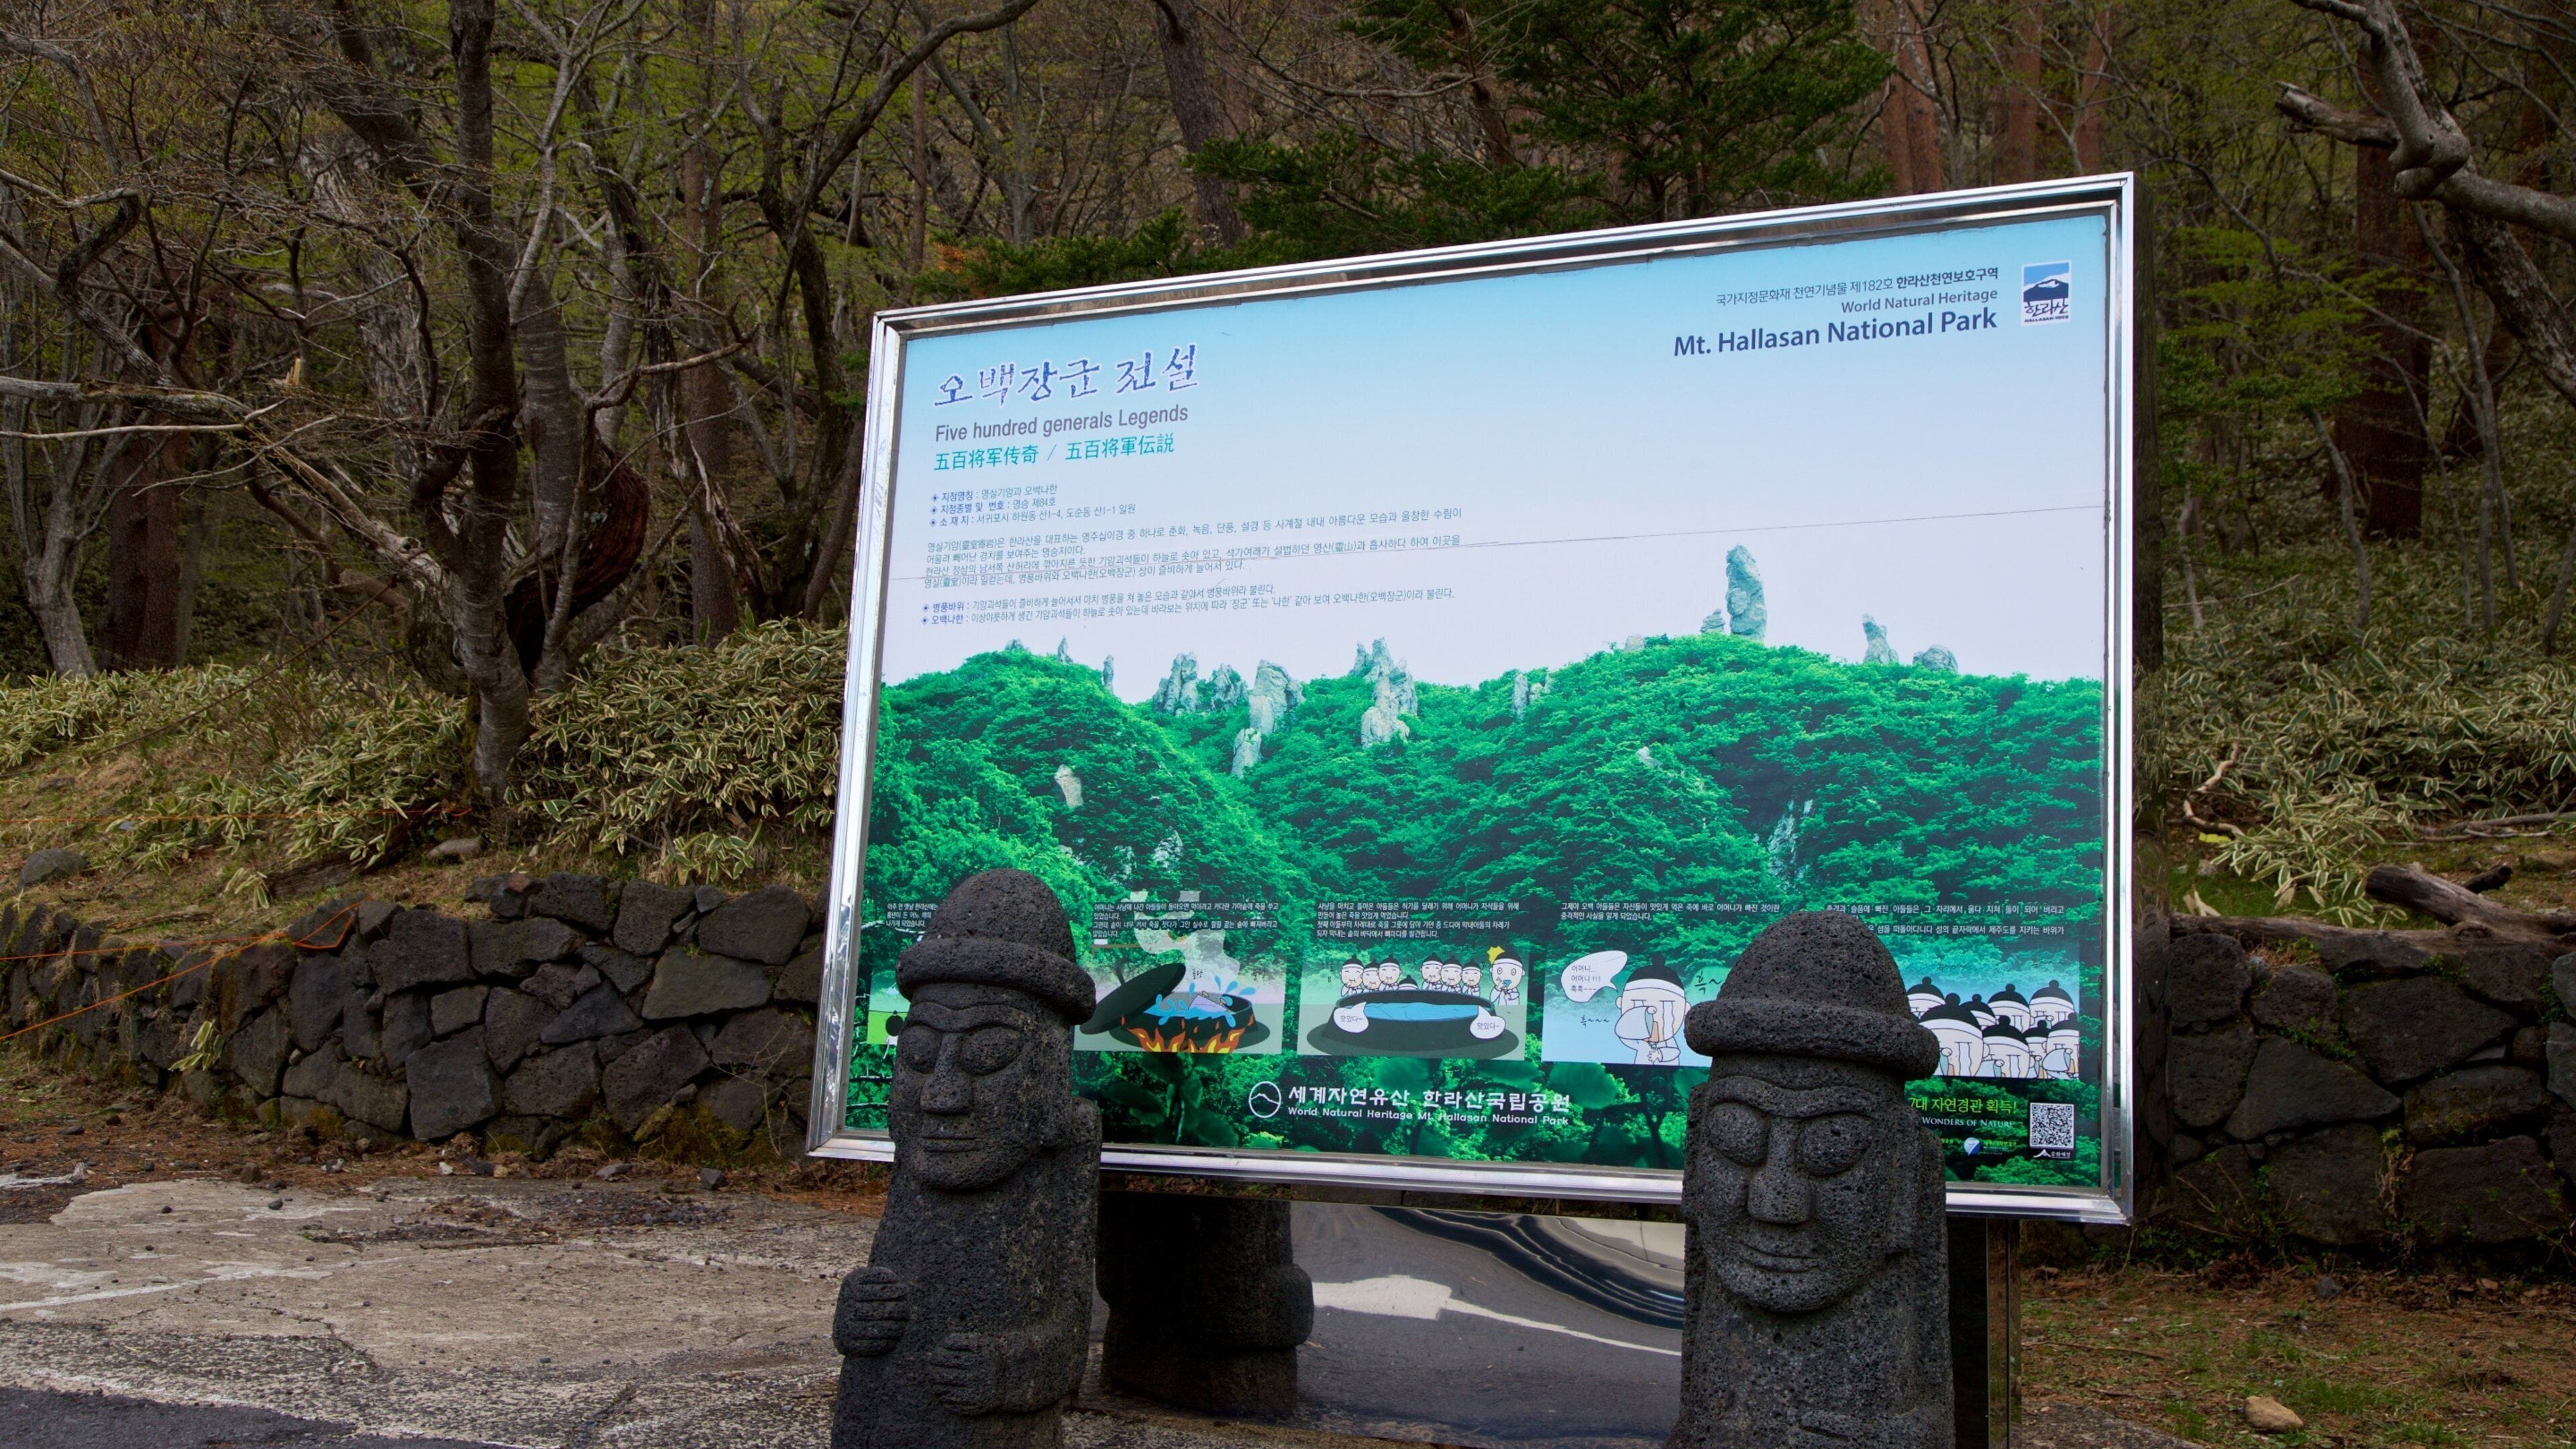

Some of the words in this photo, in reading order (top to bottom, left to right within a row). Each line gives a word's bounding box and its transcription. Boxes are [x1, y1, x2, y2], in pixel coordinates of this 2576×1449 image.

[1716, 287, 1790, 305] 국가지정문화재
[1793, 282, 1847, 299] 천연기념물
[1850, 277, 1893, 294] 제182호
[1896, 266, 1998, 290] 한라산천연보호구역
[1841, 298, 1882, 313] World
[1885, 294, 1935, 311] Natural
[1938, 289, 1998, 307] Heritage
[1674, 336, 1711, 356] Mt.
[1719, 328, 1819, 353] Hallasan
[1828, 313, 1934, 343] National
[1941, 307, 1997, 333] Park
[934, 359, 1100, 406] 오백장군
[1116, 345, 1199, 394] 전설
[935, 423, 967, 442] Five
[973, 417, 1037, 439] hundred
[1043, 411, 1112, 436] generals
[1119, 404, 1189, 429] Legends
[934, 444, 1039, 471] 五百将军传奇
[1065, 433, 1175, 461] 五百将軍伝説
[941, 490, 973, 502] 지정명칭
[981, 487, 1021, 499] 영실기암과
[1024, 484, 1057, 496] 오백나한
[941, 502, 972, 515] 지정종별
[975, 502, 983, 512] 및
[988, 500, 1004, 511] 번호
[1032, 496, 1057, 508] 제84호
[977, 513, 1009, 525] 서귀포시
[1012, 511, 1036, 523] 하원동
[1039, 508, 1063, 521] 산1-4,
[1066, 506, 1090, 519] 도순동
[1093, 505, 1115, 517] 산1-1
[1119, 503, 1136, 515] 일원
[1009, 535, 1041, 547] 한라산을
[1045, 533, 1077, 545] 대표하는
[1081, 529, 1123, 543] 영주십이경
[1127, 529, 1135, 539] 중
[1139, 527, 1165, 539] 하나로
[1217, 522, 1236, 534] 단풍,
[1241, 521, 1258, 532] 설경
[1263, 520, 1271, 531] 등
[1275, 518, 1302, 530] 사계절
[1307, 517, 1324, 528] 내내
[1328, 514, 1364, 527] 아름다운
[1370, 512, 1397, 524] 모습과
[1401, 510, 1429, 522] 울창한
[1434, 507, 1462, 519] 수림이
[1935, 905, 1963, 914] 자리에서
[2043, 905, 2064, 914] 버리고
[1571, 975, 1590, 983] 어머니
[1289, 1085, 1410, 1108] 세계자연유산
[1423, 1089, 1570, 1113] 한라산국립공원
[1931, 1097, 1983, 1114] 자연경관
[1986, 1098, 2017, 1114] 획득!
[1289, 1107, 1318, 1117] World
[1322, 1108, 1362, 1118] Natural
[1367, 1110, 1413, 1121] Heritage
[1439, 1112, 1487, 1122] Hallasan
[1492, 1114, 1538, 1124] National
[1543, 1115, 1569, 1126] Park
